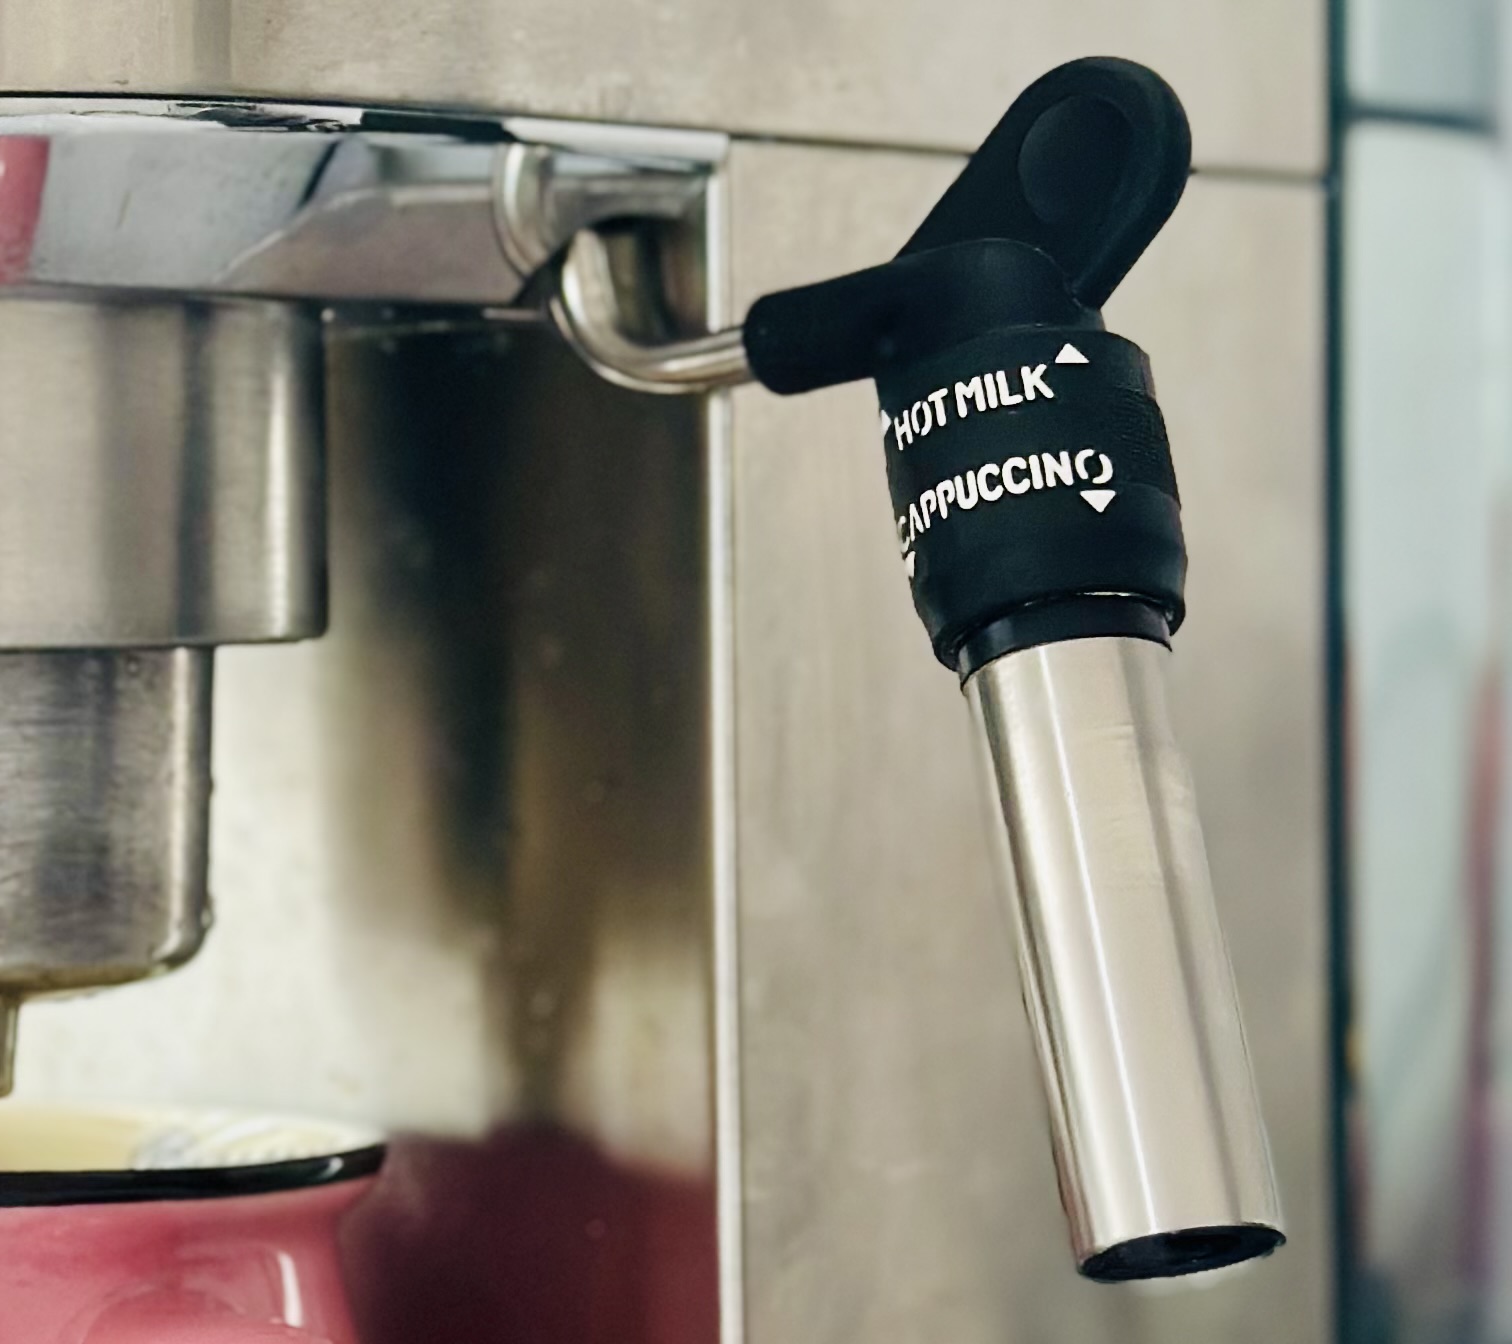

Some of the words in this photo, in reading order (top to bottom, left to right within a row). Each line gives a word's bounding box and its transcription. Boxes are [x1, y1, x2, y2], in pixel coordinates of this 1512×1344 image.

[894, 388, 948, 450] HOT
[955, 364, 1054, 418] MILK
[898, 449, 1113, 552] CAPPUCCINO
